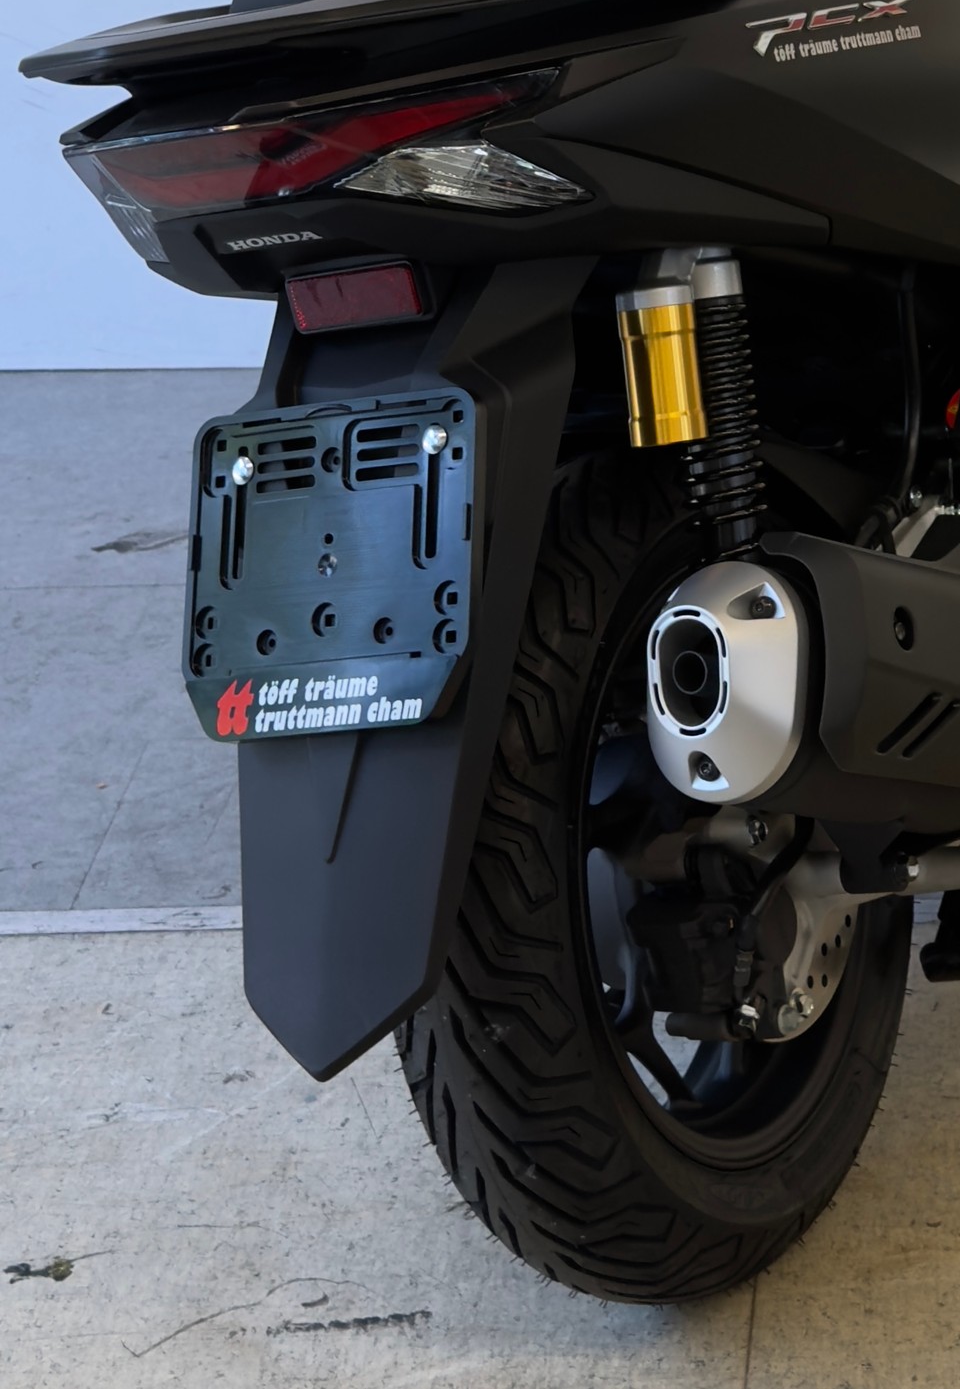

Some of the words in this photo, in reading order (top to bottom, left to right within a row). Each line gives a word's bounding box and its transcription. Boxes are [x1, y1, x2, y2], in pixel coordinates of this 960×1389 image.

[773, 43, 796, 62] töff
[799, 38, 839, 58] träume
[840, 30, 894, 51] truttmann
[895, 24, 922, 42] cham
[227, 231, 323, 251] HONDA
[258, 678, 299, 707] töff
[304, 675, 379, 702] träume
[254, 703, 362, 733] truttmann
[366, 696, 423, 723] cham
